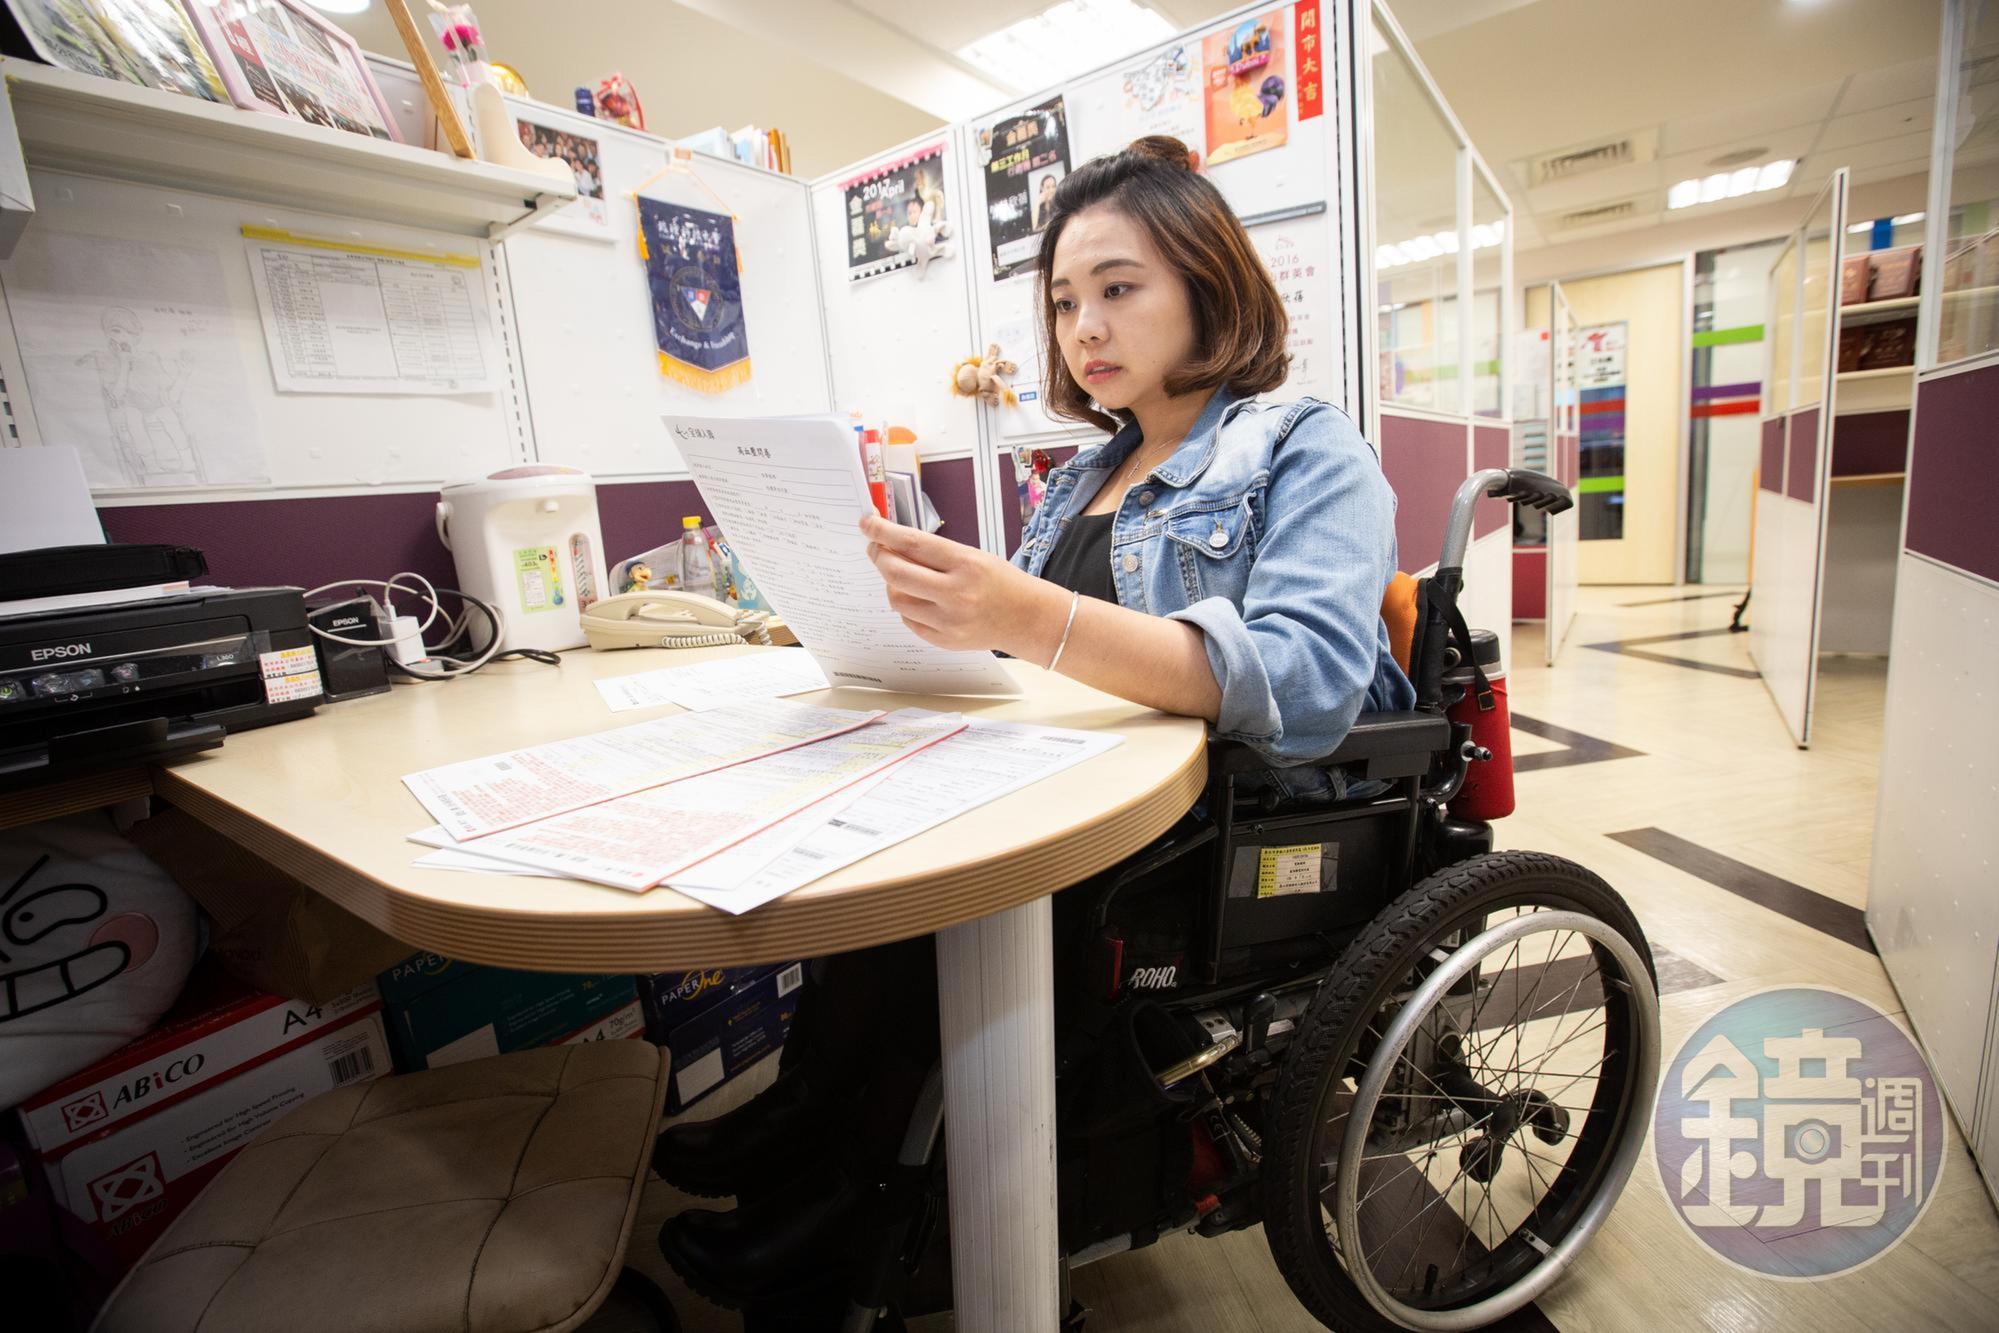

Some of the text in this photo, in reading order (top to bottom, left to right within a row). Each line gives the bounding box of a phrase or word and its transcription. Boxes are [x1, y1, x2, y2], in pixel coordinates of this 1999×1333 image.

[1301, 8, 1318, 101] 開市大吉
[863, 178, 890, 201] 2017
[1271, 255, 1299, 268] 2016
[332, 616, 359, 627] EPSON
[31, 642, 92, 662] EPSON
[1128, 966, 1176, 989] ROHO
[283, 1006, 323, 1035] A4
[113, 1053, 205, 1109] ABiCO
